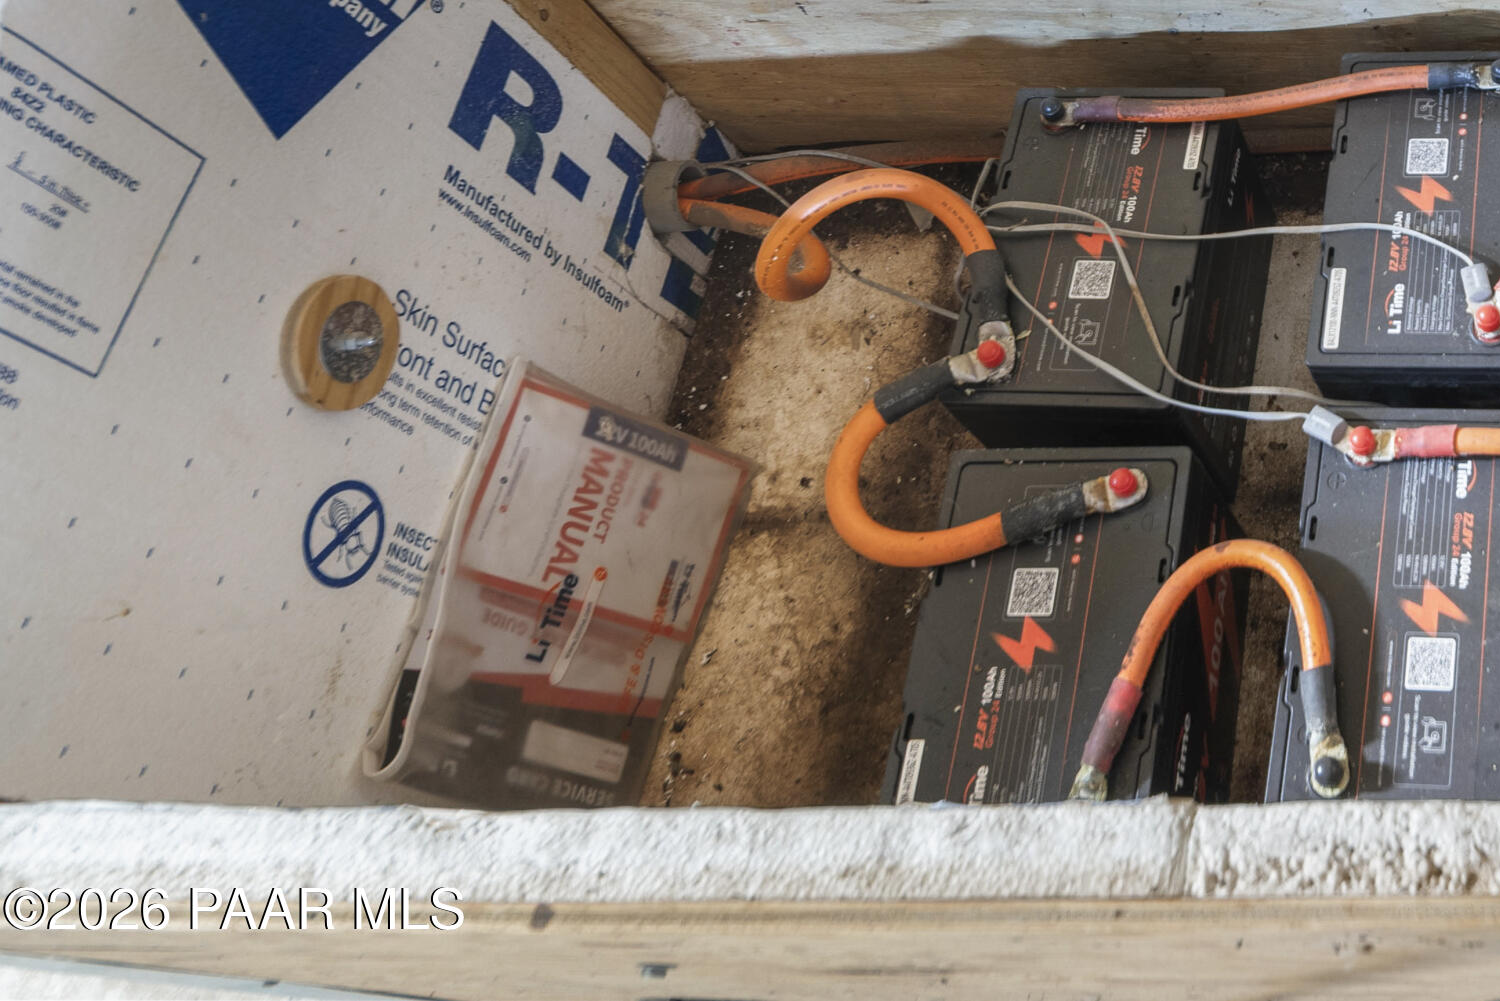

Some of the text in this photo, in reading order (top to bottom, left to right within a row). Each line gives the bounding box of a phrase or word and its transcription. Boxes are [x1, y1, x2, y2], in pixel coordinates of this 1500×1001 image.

[37, 82, 98, 125] PLASTIC
[25, 116, 141, 193] CHARACTERISTIC
[1131, 127, 1147, 155] Time
[443, 164, 546, 250] Manufactured
[541, 232, 567, 267] by
[1117, 200, 1126, 221] Edition
[1123, 166, 1143, 223] 12.8V 100Ah
[1388, 241, 1400, 272] 12.8V
[1399, 246, 1408, 271] Group
[393, 288, 439, 341] Skin
[1388, 284, 1405, 334] Li Time
[433, 364, 479, 412] and
[592, 457, 636, 546] PRODUCT
[1455, 460, 1472, 499] Time
[541, 448, 616, 583] MANUAL
[1450, 513, 1463, 587] Group 24 Edition
[1459, 512, 1474, 589] 12.8V 100Ah
[525, 570, 582, 665] Li Time
[973, 666, 998, 750] 12.8V 100Ah
[985, 714, 998, 748] Group
